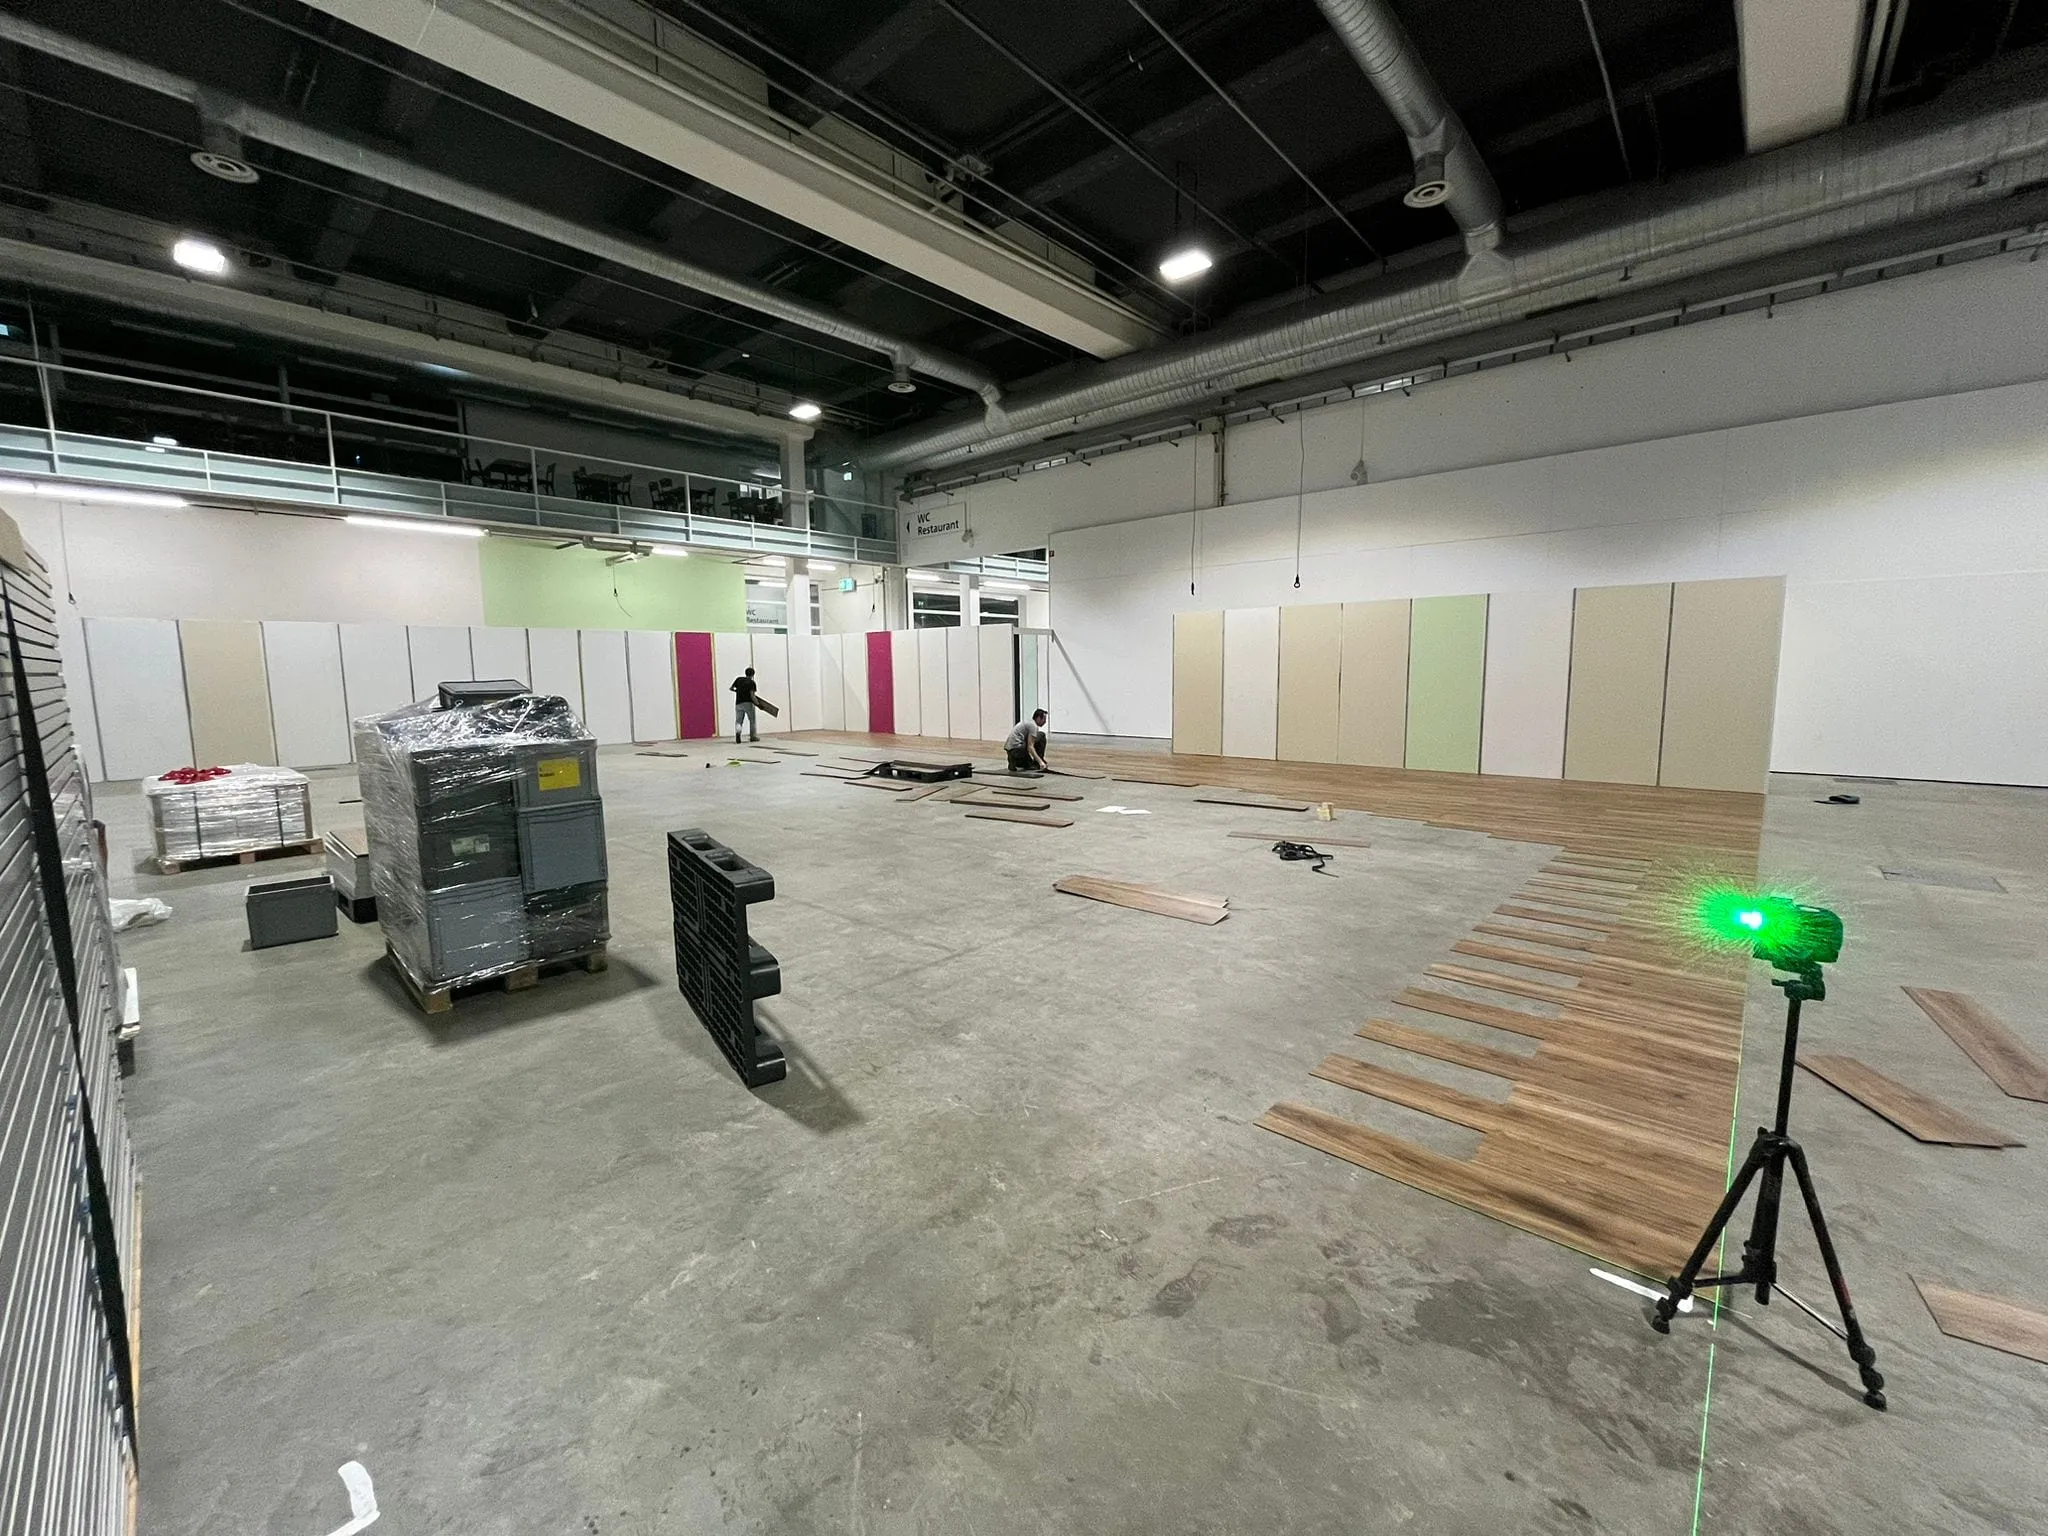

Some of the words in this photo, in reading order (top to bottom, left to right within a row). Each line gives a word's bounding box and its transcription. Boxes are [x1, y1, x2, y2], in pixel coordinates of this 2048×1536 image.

[918, 512, 930, 524] WC
[918, 520, 959, 536] Restaurant
[746, 608, 756, 616] WC
[746, 616, 779, 624] Restaurant
